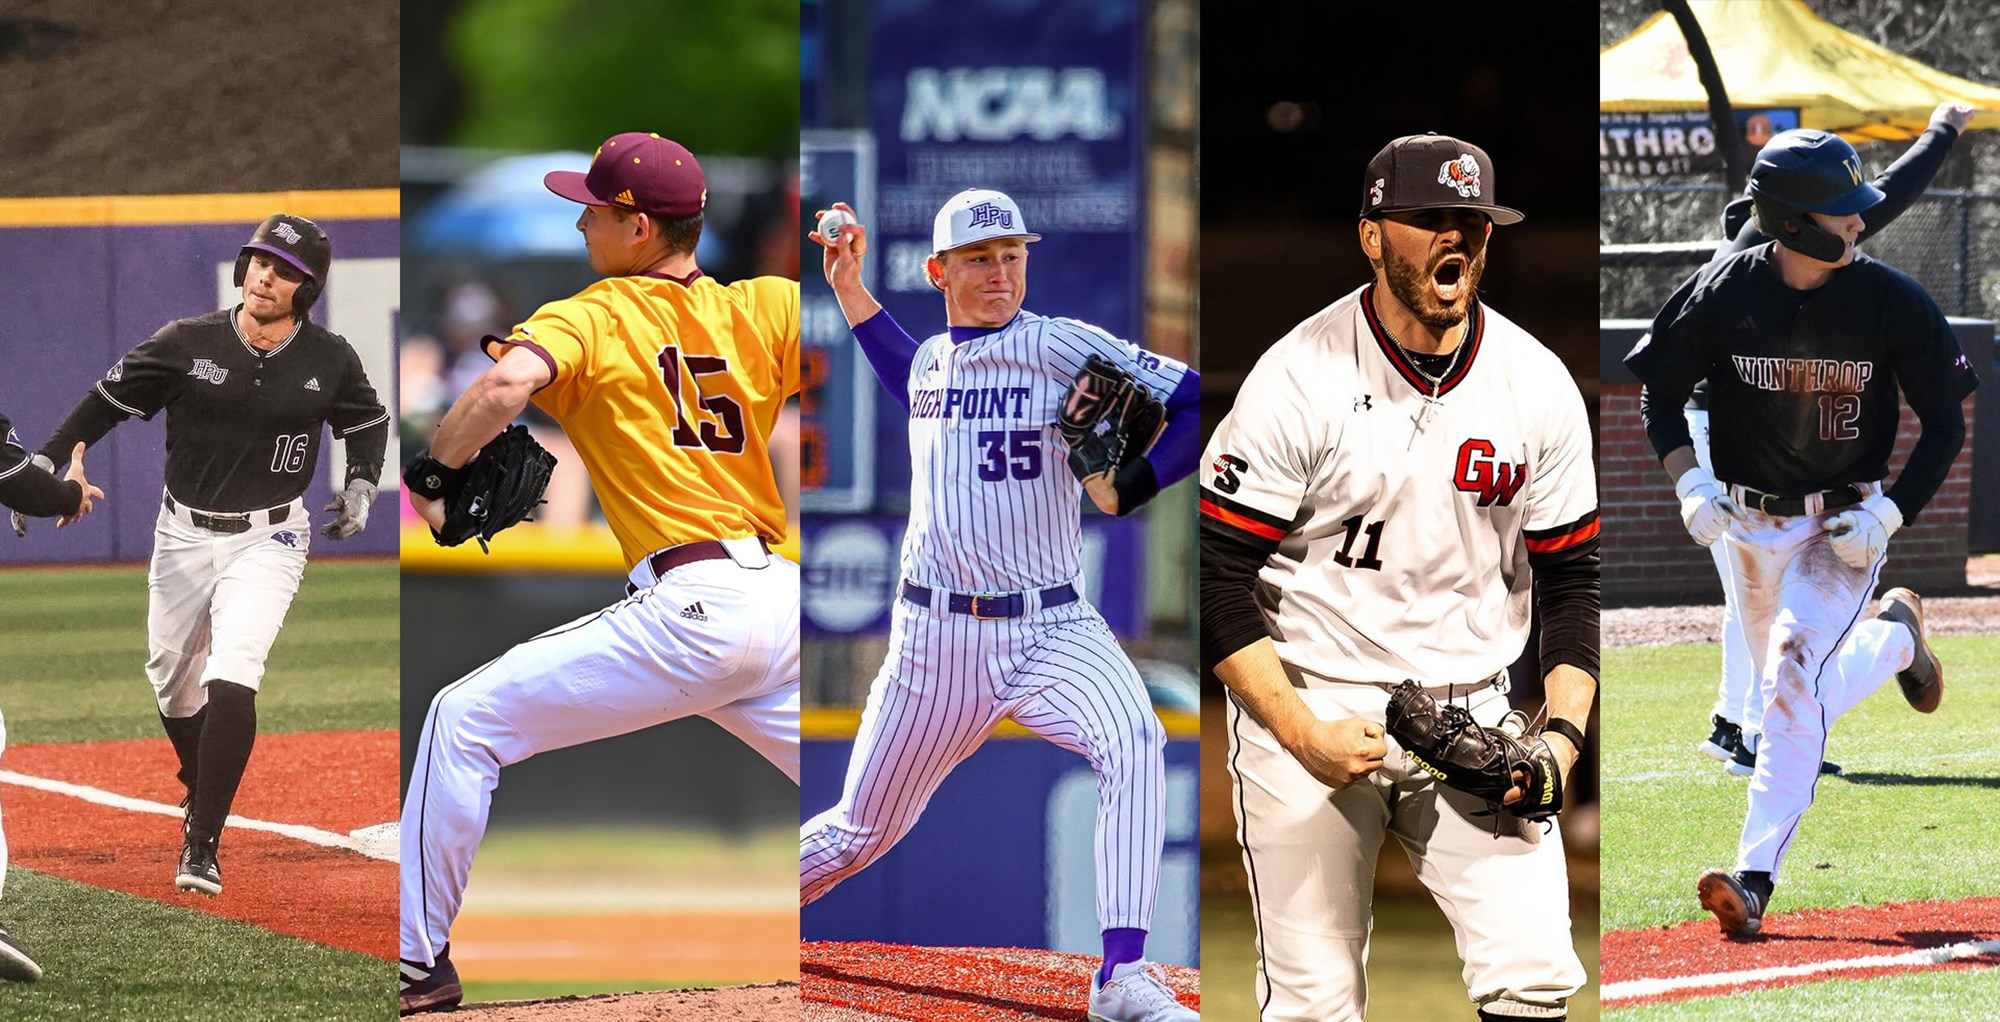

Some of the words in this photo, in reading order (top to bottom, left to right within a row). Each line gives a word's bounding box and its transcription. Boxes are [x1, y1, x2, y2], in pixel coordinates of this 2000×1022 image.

[903, 67, 1110, 142] NCAA
[1600, 126, 1716, 157] THRO
[271, 222, 302, 245] HPU
[968, 202, 1013, 230] HPU
[187, 358, 229, 385] HPU
[1732, 355, 1873, 392] WINTHROP
[656, 344, 746, 456] 15
[911, 388, 944, 419] HIGH
[943, 387, 1030, 420] POINT
[1819, 395, 1861, 440] 12
[270, 433, 309, 472] 16
[977, 430, 1042, 482] 35
[1452, 438, 1526, 507] GW
[1333, 514, 1386, 572] 11
[680, 611, 708, 622] adidas
[1405, 750, 1448, 781] A2000
[1539, 757, 1553, 805] Wilson
